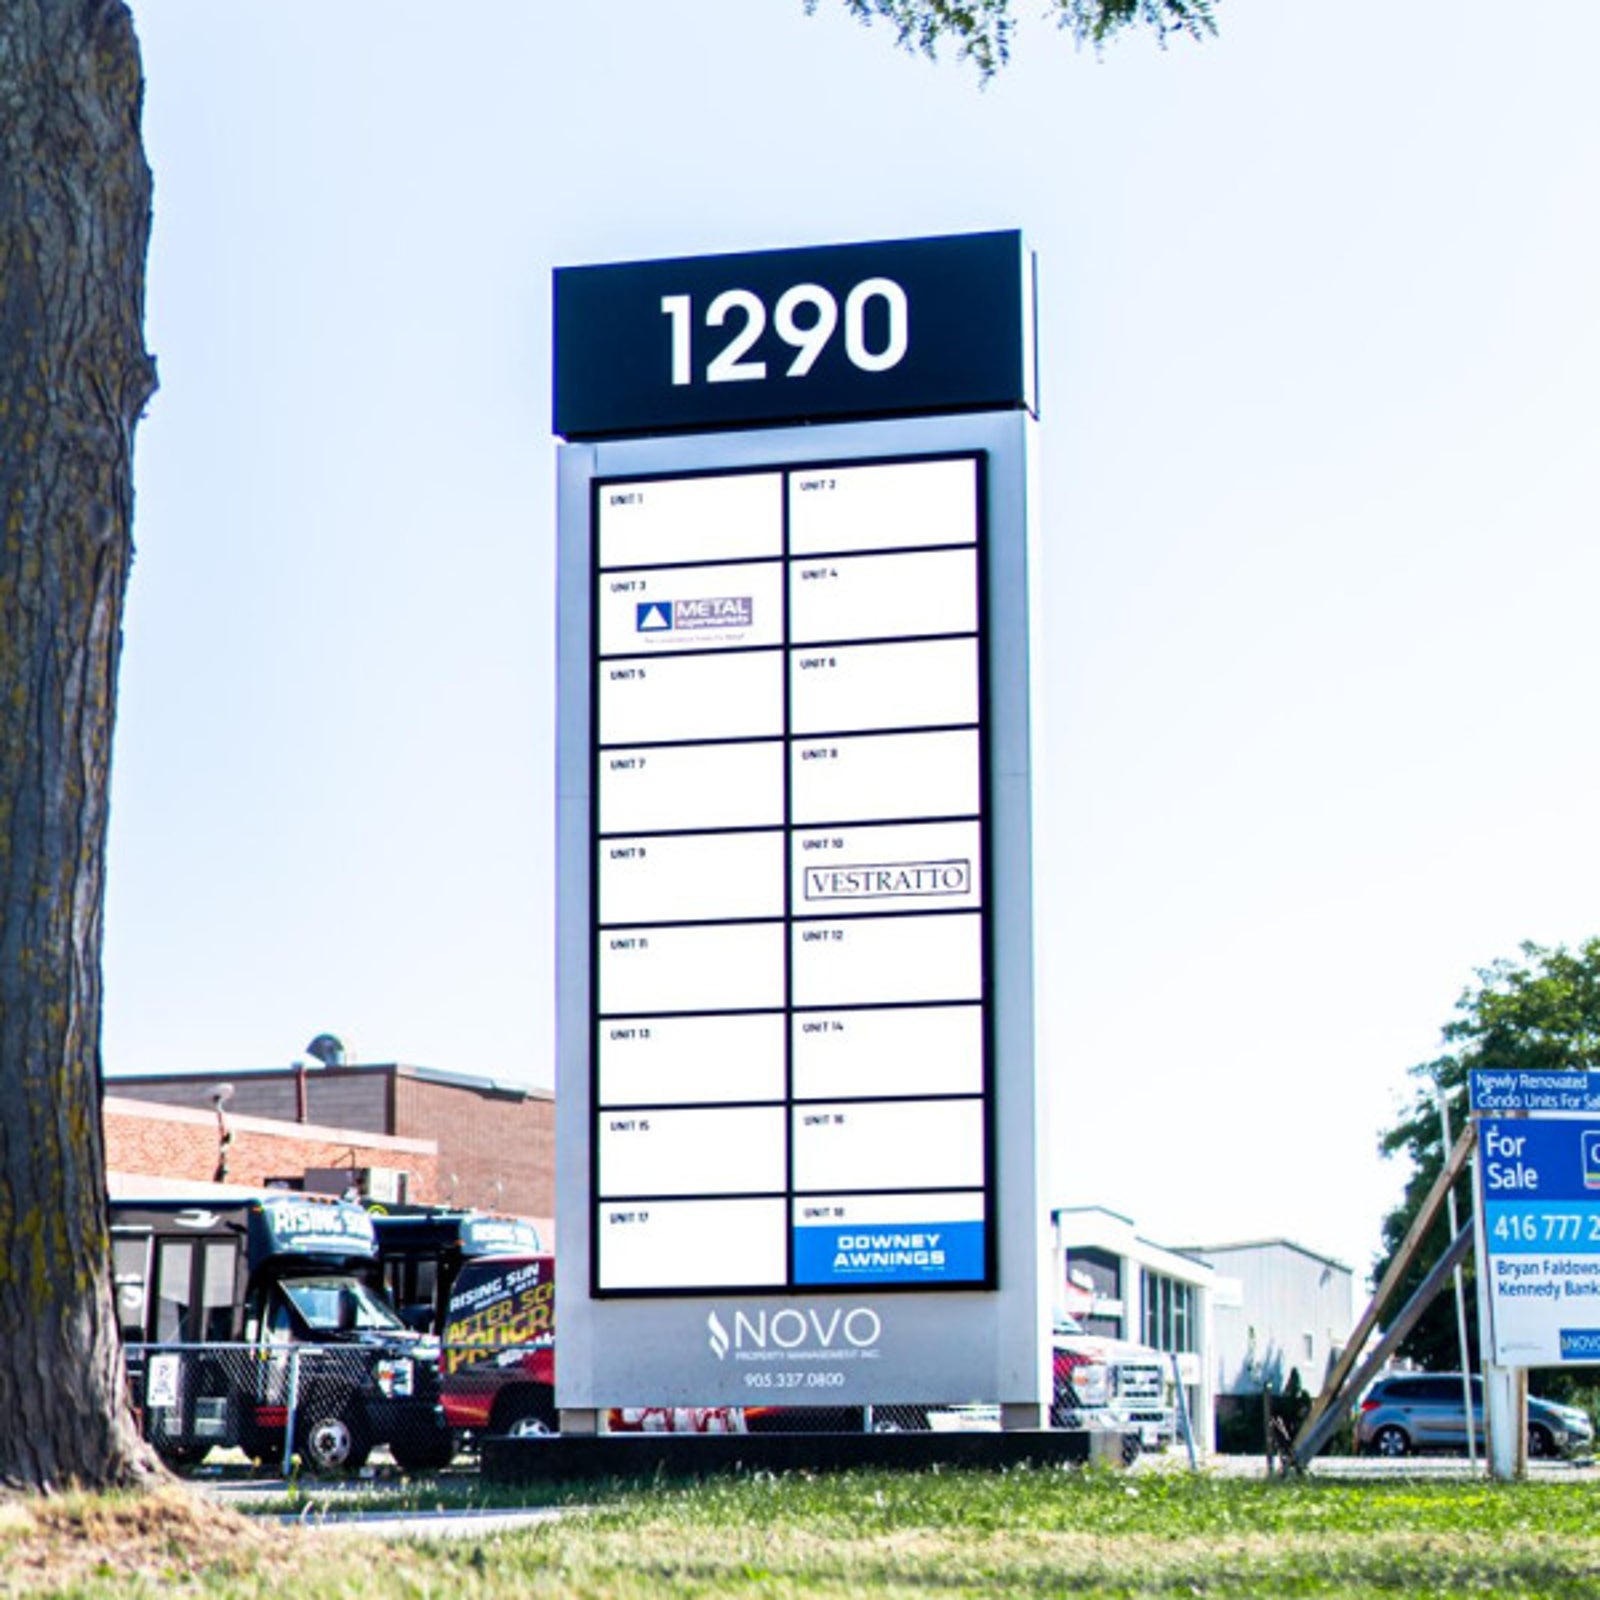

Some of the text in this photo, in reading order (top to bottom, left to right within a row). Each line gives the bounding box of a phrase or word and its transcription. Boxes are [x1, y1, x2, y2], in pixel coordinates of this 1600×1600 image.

[661, 277, 908, 385] 1290
[800, 480, 825, 491] UNIT
[610, 494, 634, 505] UNIT
[802, 569, 826, 579] UNIT
[611, 581, 635, 592] UNIT
[676, 599, 749, 618] METAL
[800, 658, 826, 669] UNIT
[610, 669, 635, 680] UNIT
[802, 749, 827, 760] UNIT
[610, 759, 635, 770] UNIT
[803, 839, 828, 850] UNIT
[610, 848, 635, 859] UNIT
[811, 866, 964, 895] VESTRATTO
[803, 930, 828, 941] UNIT
[610, 939, 635, 950] UNIT
[803, 1021, 828, 1033] UNIT
[611, 1029, 635, 1040] UNIT
[1477, 1074, 1588, 1093] Newly Renovated
[1477, 1091, 1521, 1108] Condo
[1525, 1092, 1558, 1108] Units
[1561, 1093, 1580, 1107] For
[804, 1115, 829, 1125] UNIT
[611, 1121, 635, 1131] UNIT
[1486, 1131, 1526, 1157] For
[1487, 1161, 1538, 1188] Sale
[610, 1213, 634, 1224] UNIT
[805, 1208, 830, 1218] UNIT
[1494, 1215, 1537, 1241] 416
[1541, 1215, 1582, 1241] 777
[837, 1233, 941, 1250] DOWNEY
[833, 1250, 946, 1268] AWNINGS
[1497, 1260, 1539, 1280] Bryan
[450, 1277, 502, 1313] RISING
[506, 1262, 540, 1288] SUN
[1499, 1280, 1561, 1300] Kennedy
[735, 1307, 882, 1349] NOVO
[447, 1304, 557, 1375] PROGR
[1568, 1335, 1600, 1351] NOV
